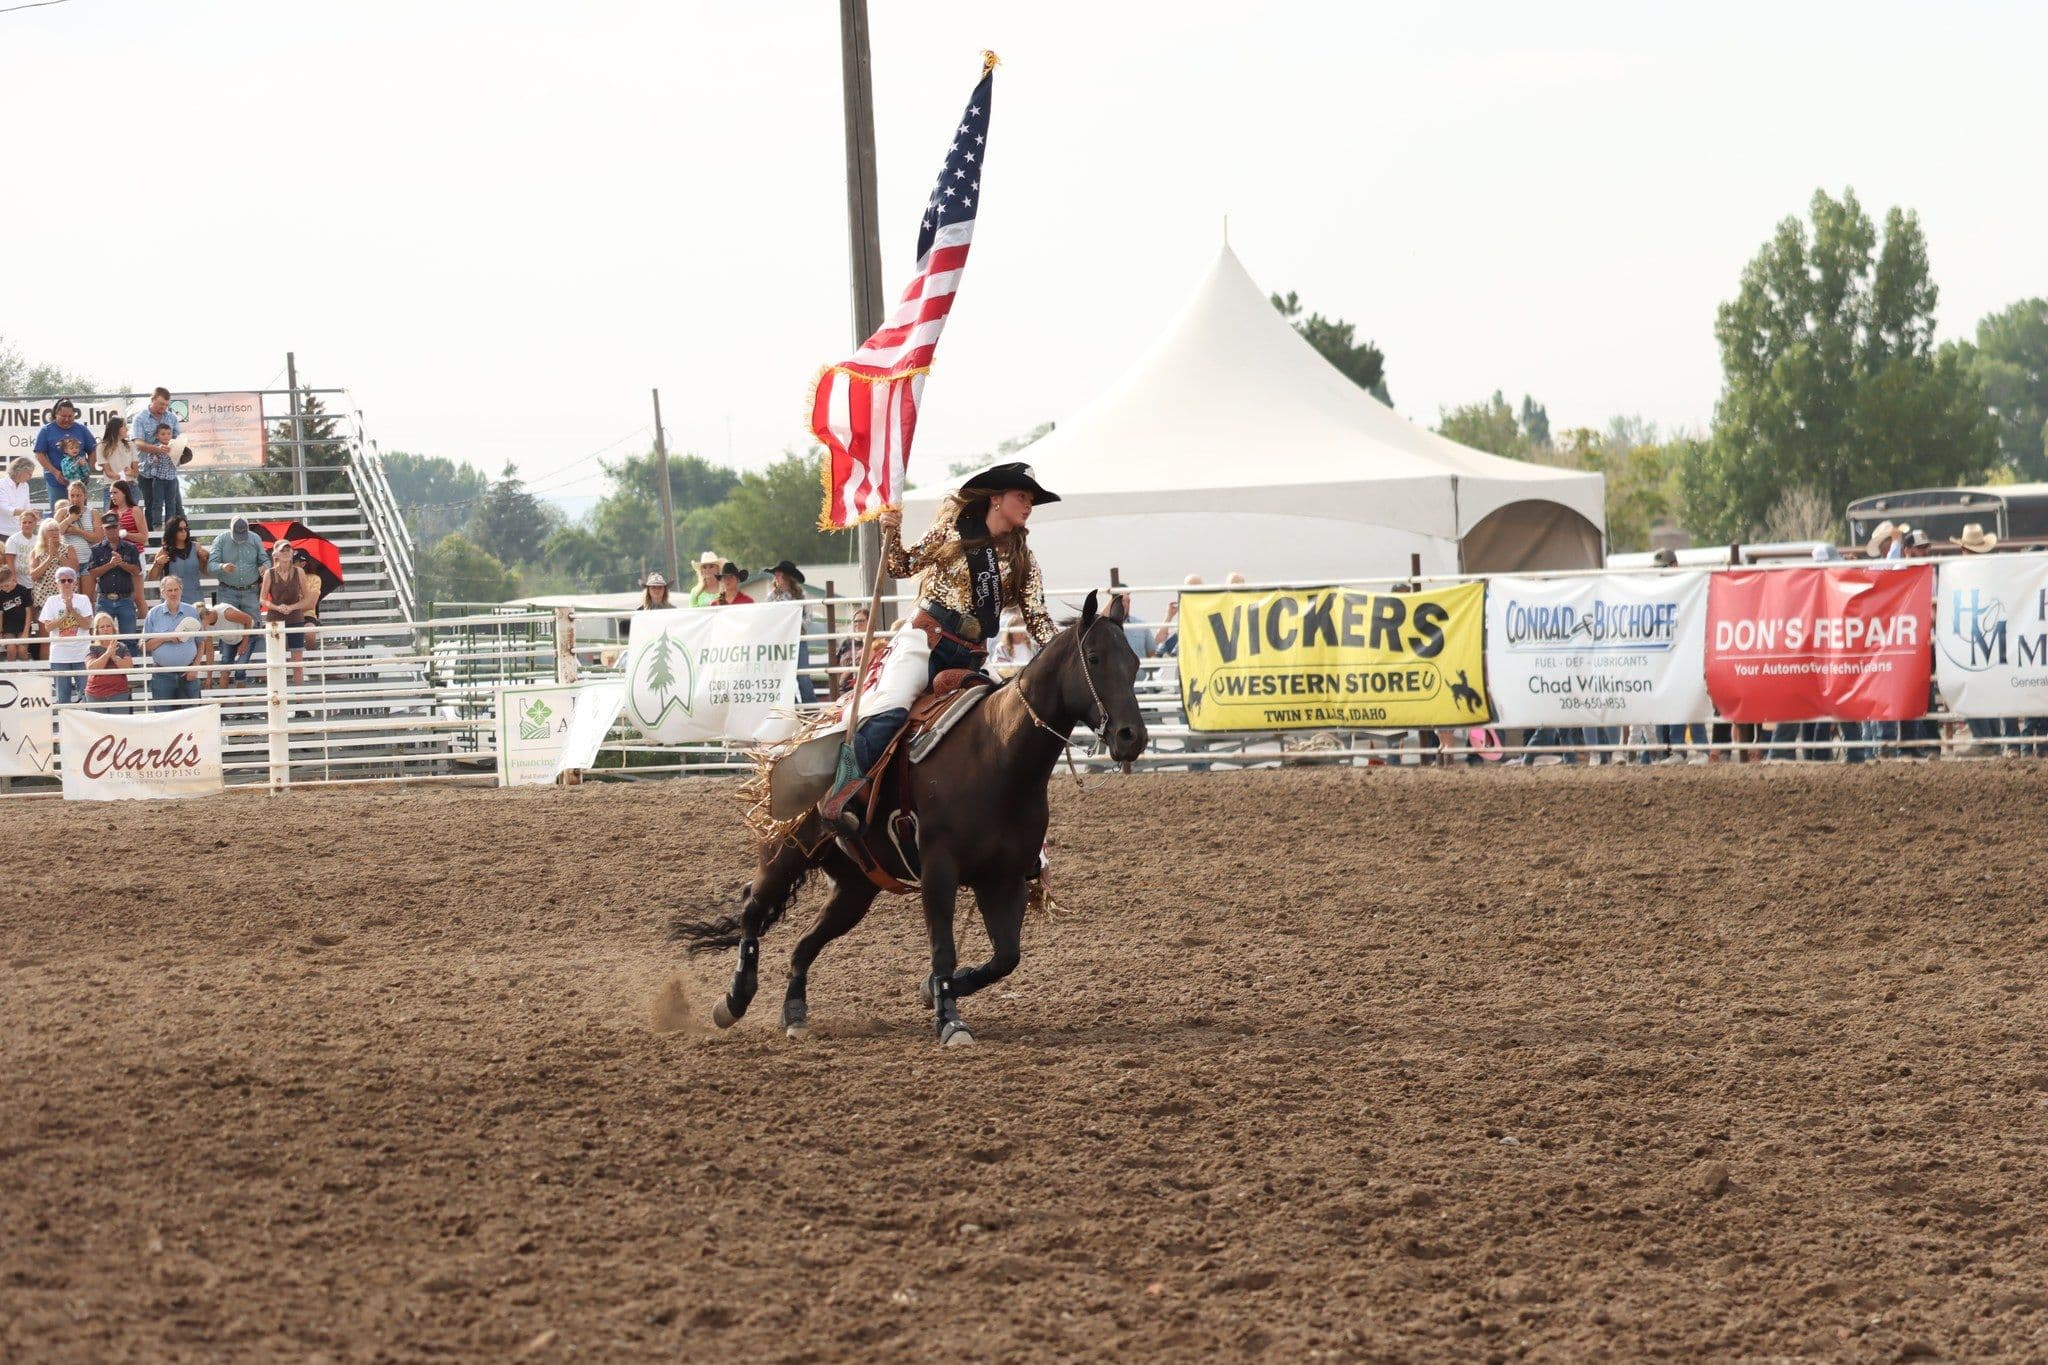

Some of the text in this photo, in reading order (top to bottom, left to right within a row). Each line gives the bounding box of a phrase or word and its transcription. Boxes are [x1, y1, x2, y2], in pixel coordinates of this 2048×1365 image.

[209, 403, 252, 413] Harrison
[1208, 593, 1449, 663] VICKERS
[1506, 600, 1574, 643] CONRAD
[1594, 600, 1677, 641] BISCHOFF
[1715, 615, 1917, 651] DON'S REPAIR
[700, 643, 797, 665] ROUGH PINE
[1535, 657, 1557, 668] FUEL
[1566, 656, 1584, 667] DEF
[1594, 655, 1648, 667] LUBRICANTS
[1734, 664, 1759, 677] Your
[733, 679, 781, 690] 260-1537
[1226, 671, 1420, 697] WESTERN STORE
[1529, 674, 1653, 694] Chad Wilkinson
[1264, 709, 1301, 723] TWIN
[1350, 708, 1386, 721] IDAHO
[83, 732, 202, 779] Clark's
[109, 768, 201, 779] FOR SHOPPING
